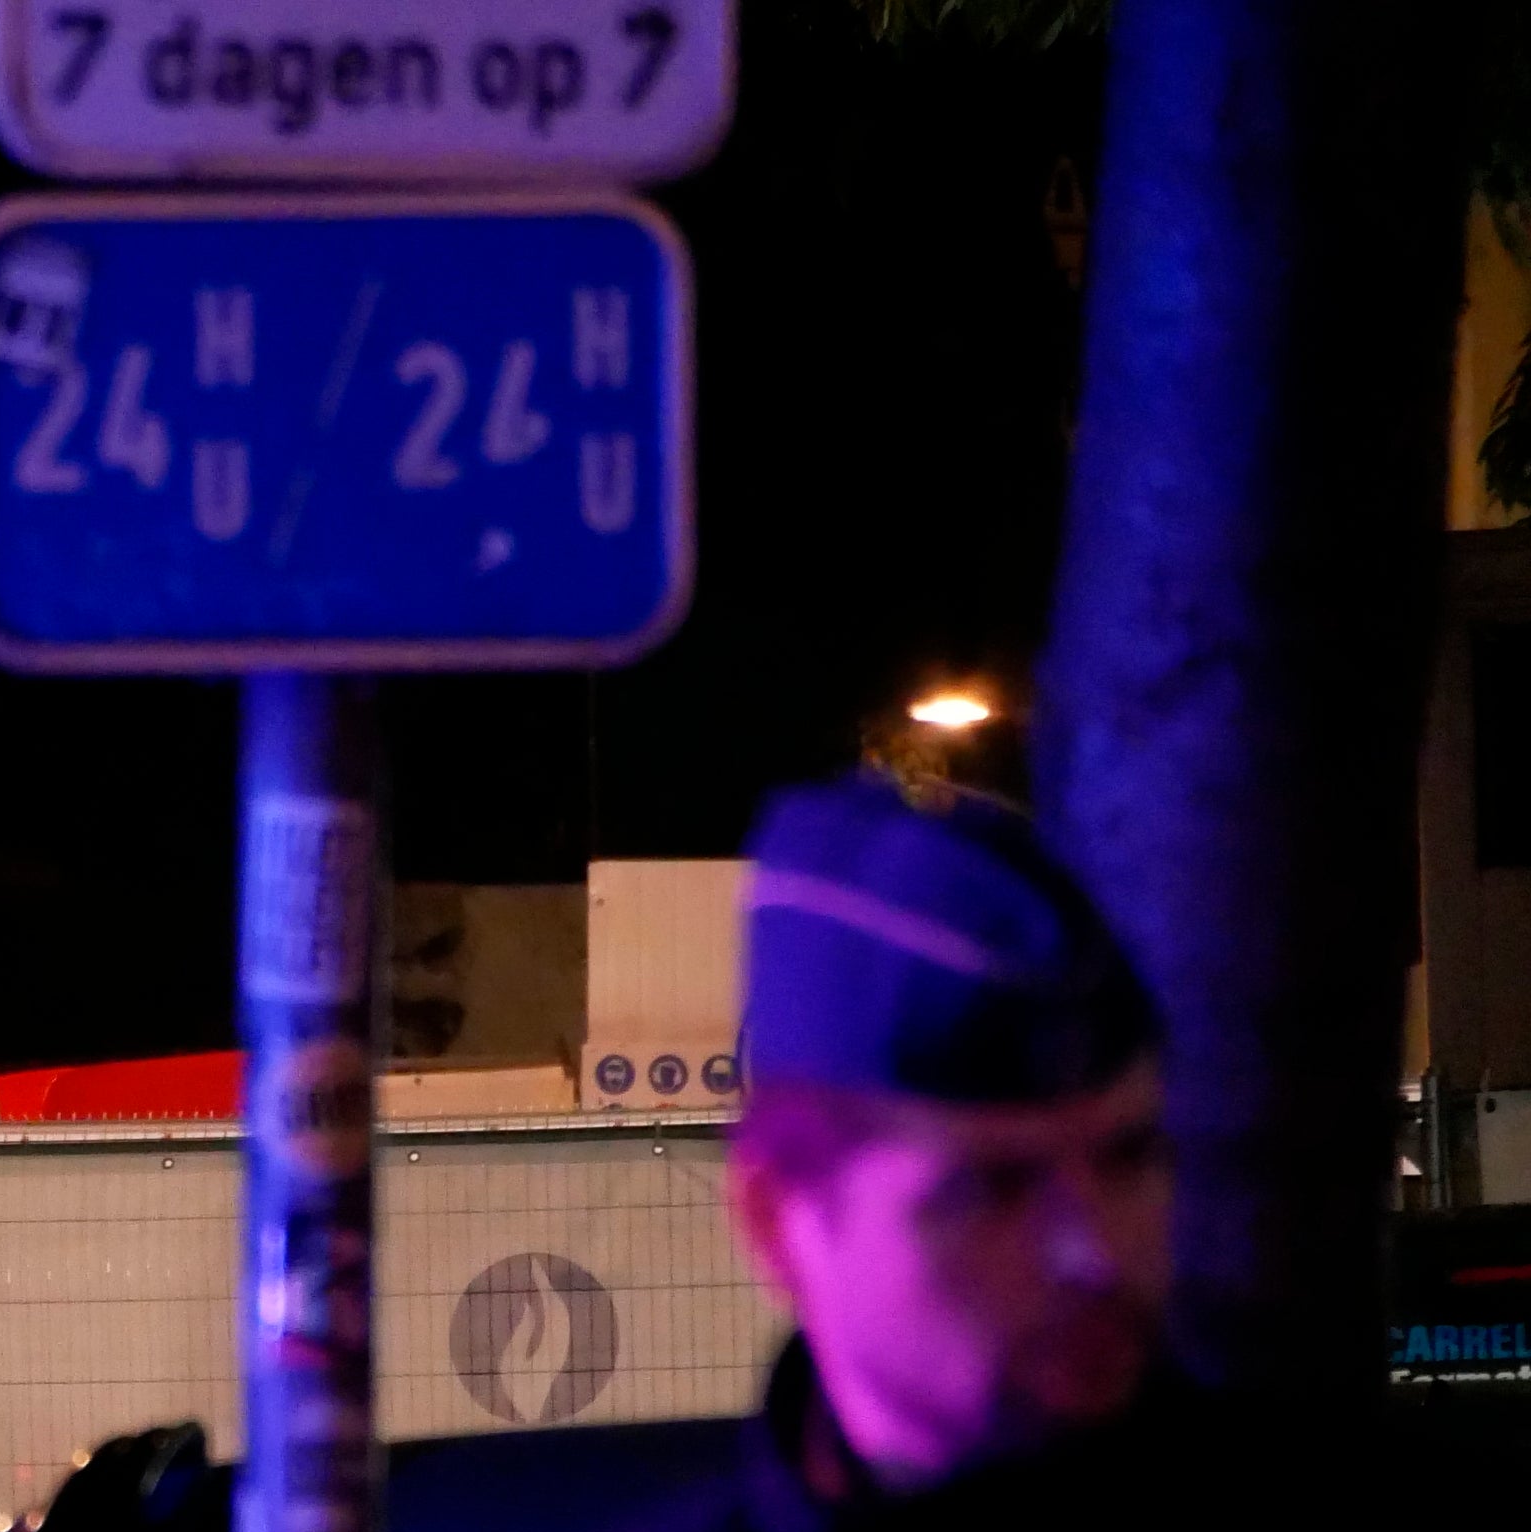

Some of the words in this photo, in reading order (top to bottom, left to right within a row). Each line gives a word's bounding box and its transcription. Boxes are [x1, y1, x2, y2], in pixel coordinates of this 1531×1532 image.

[45, 9, 109, 106] 7
[144, 16, 437, 136] dagen
[472, 39, 584, 137] op
[621, 9, 676, 107] 7
[13, 346, 170, 493] 24
[194, 287, 255, 388] H
[571, 287, 630, 388] H
[193, 440, 251, 541] U
[579, 434, 636, 534] U
